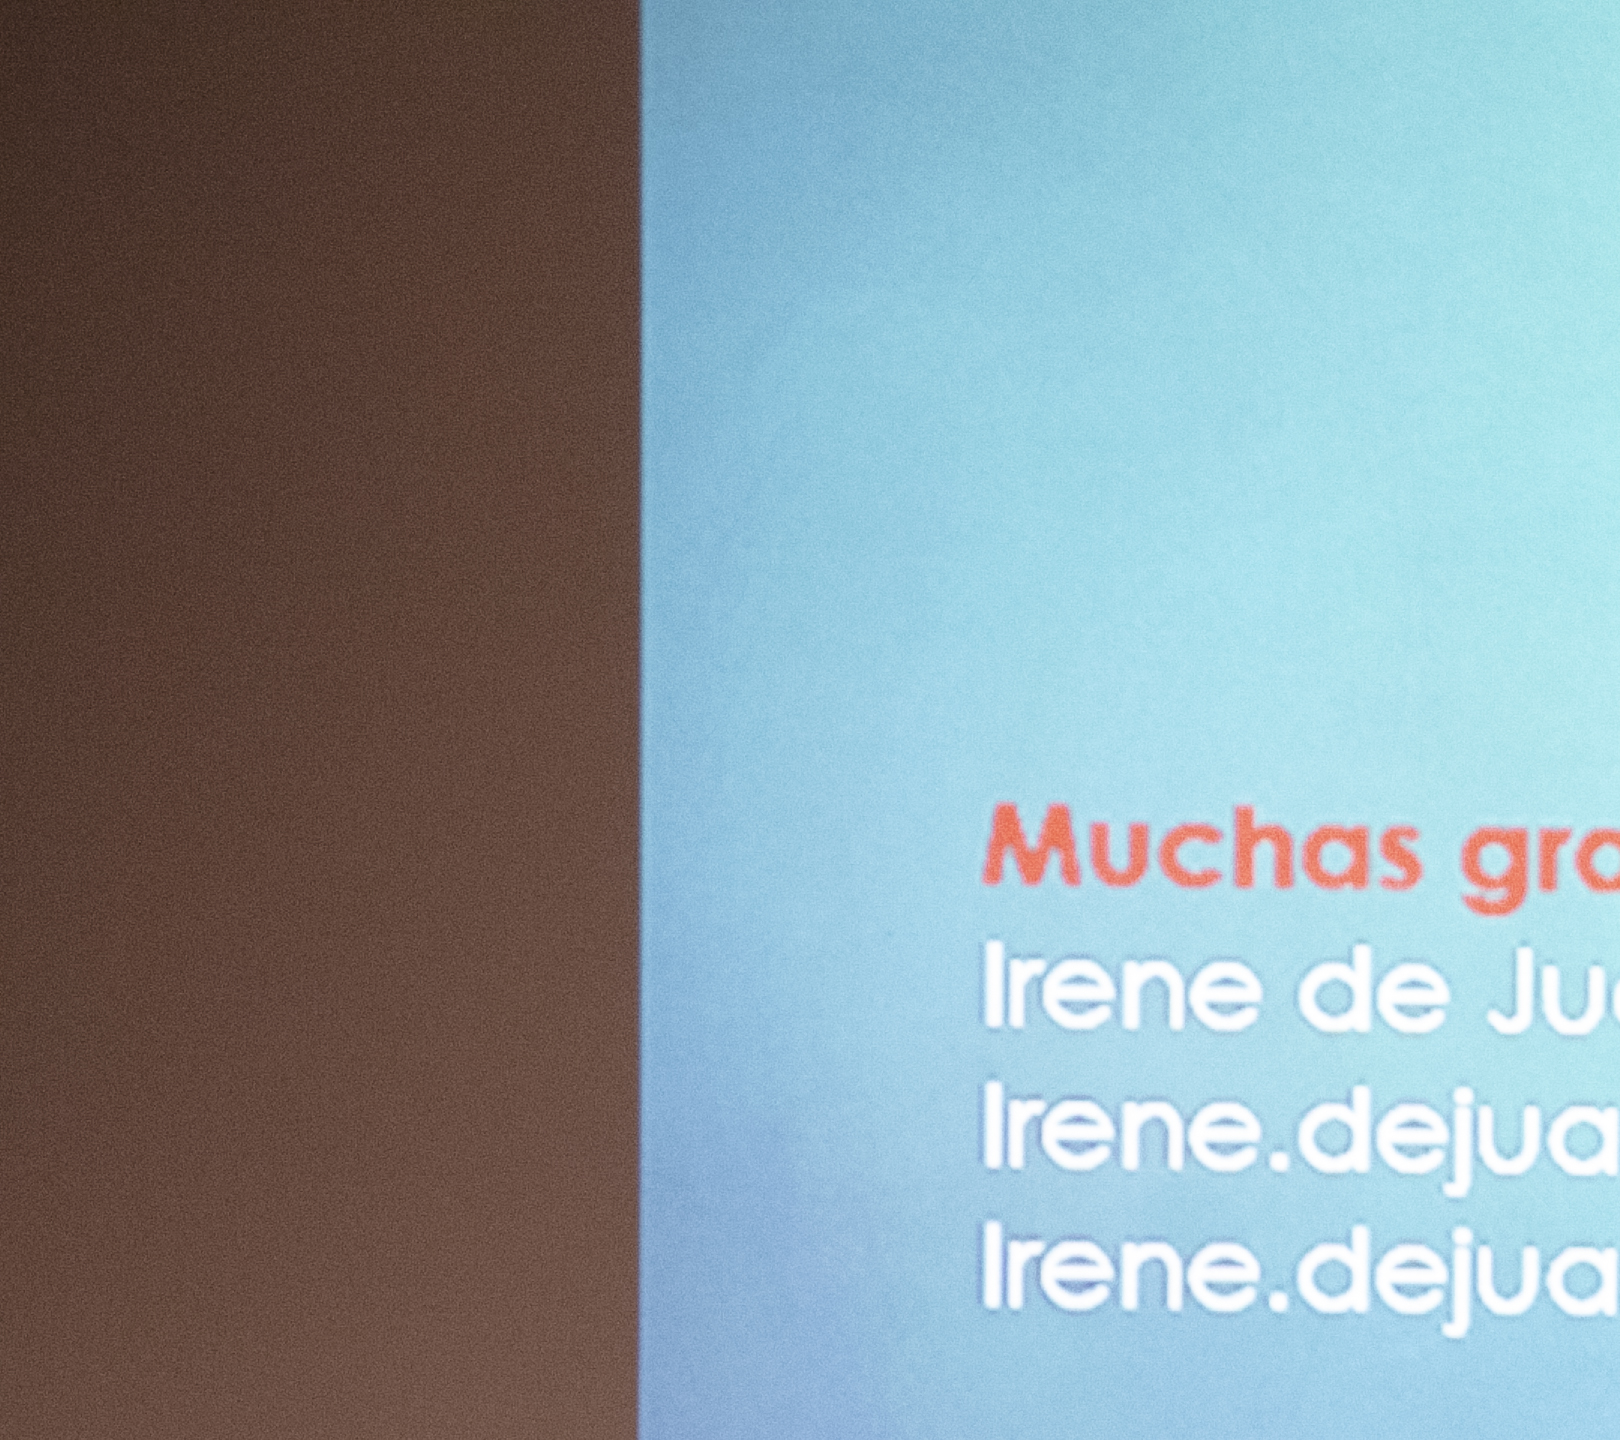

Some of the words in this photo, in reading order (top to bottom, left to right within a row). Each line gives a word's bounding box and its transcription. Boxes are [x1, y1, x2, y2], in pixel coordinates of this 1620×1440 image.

[983, 803, 1422, 890] Muchas
[983, 940, 1263, 1033] Irene
[1299, 945, 1450, 1035] de
